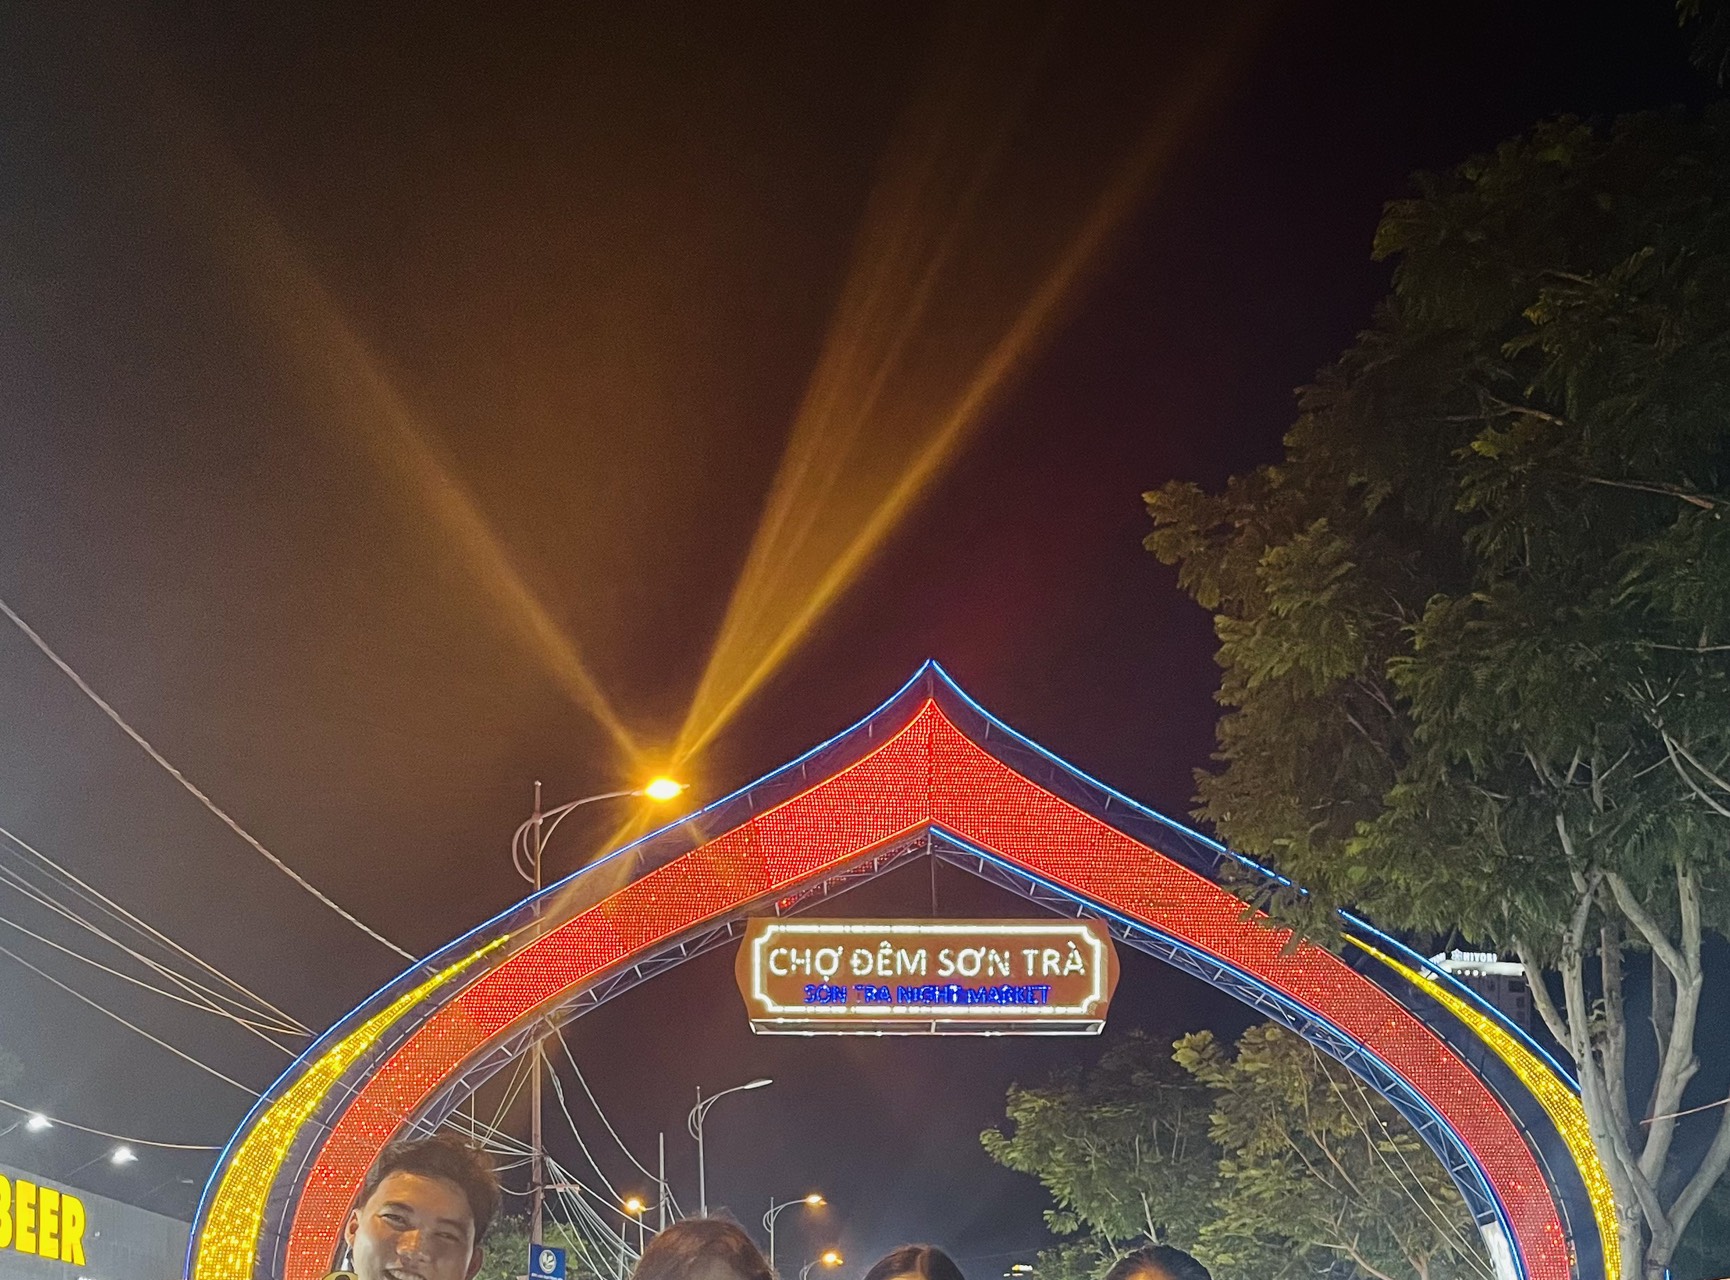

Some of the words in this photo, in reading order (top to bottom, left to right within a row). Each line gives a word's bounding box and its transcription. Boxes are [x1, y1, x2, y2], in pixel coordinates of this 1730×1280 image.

[769, 945, 844, 983] CHỢ
[850, 940, 927, 976] ĐÊM
[937, 946, 1010, 977] SƠN
[1022, 940, 1086, 977] TRÀ
[897, 984, 961, 1004] NIGHT
[966, 984, 1051, 1004] MARKET
[0, 1173, 87, 1267] BEER
